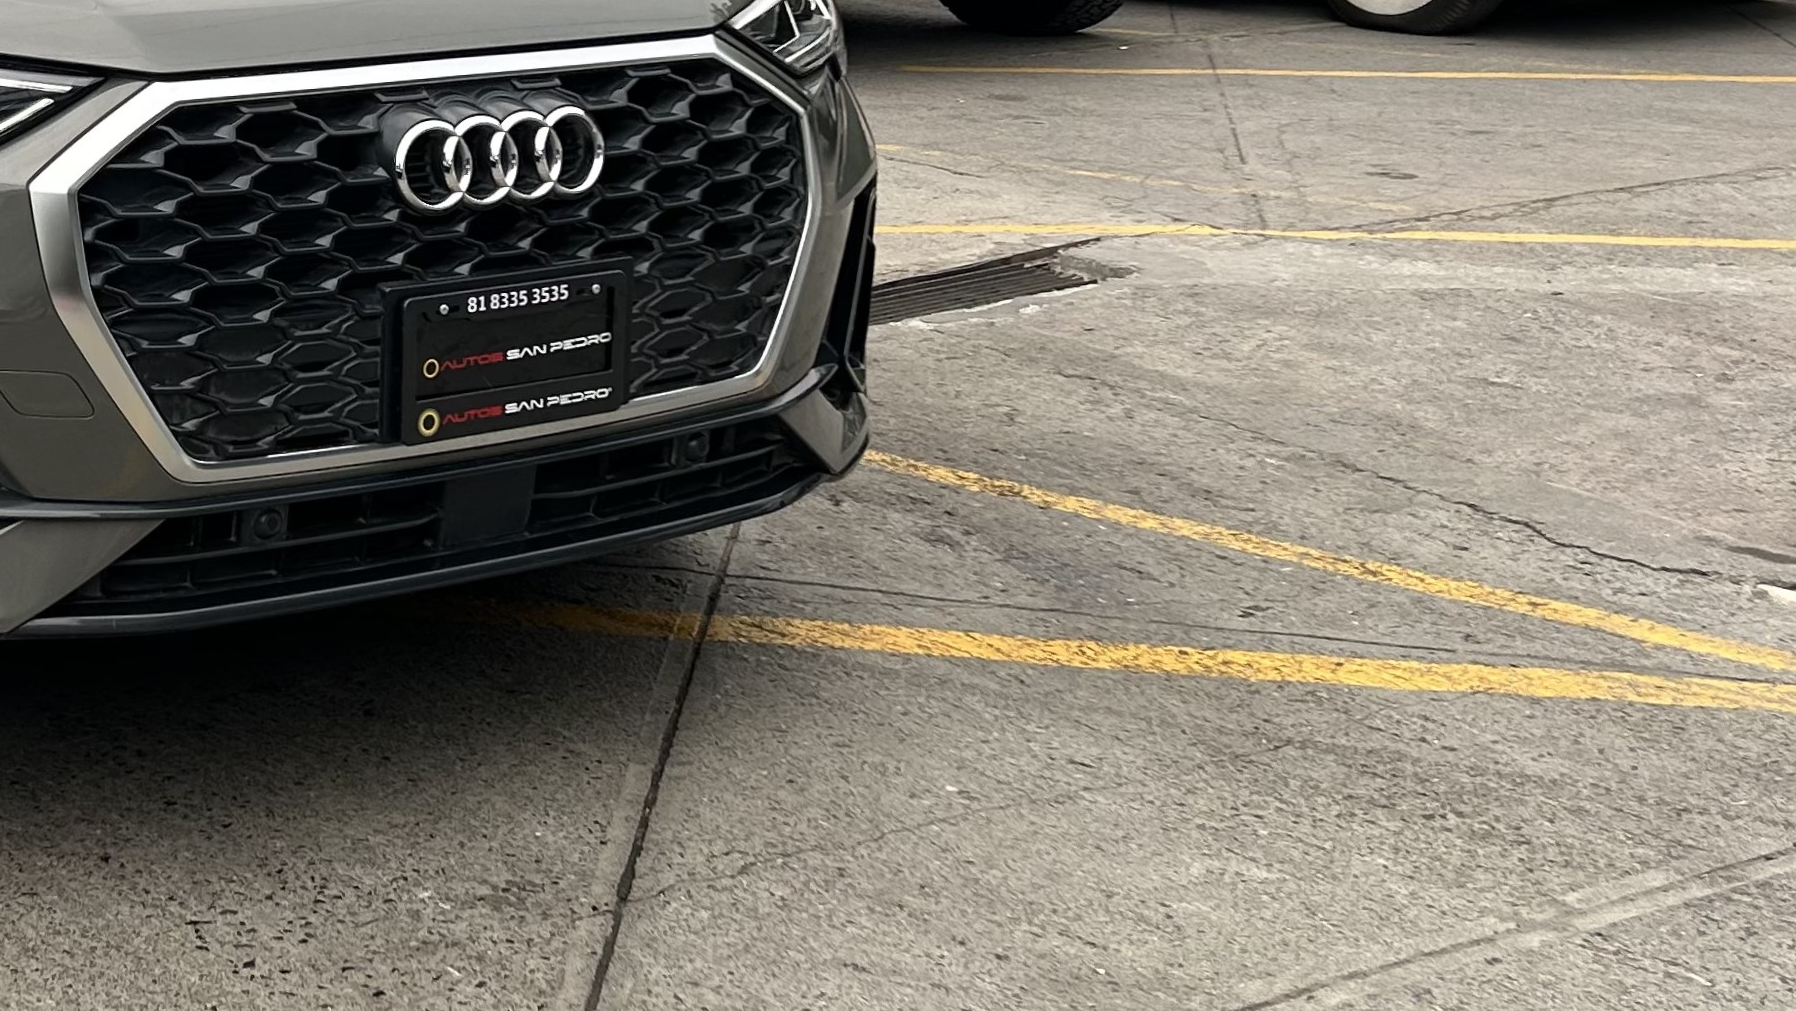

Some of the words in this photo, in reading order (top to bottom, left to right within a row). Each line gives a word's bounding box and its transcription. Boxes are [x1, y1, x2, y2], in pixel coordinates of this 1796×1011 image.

[467, 295, 487, 313] 81
[490, 290, 528, 310] 8335
[531, 284, 569, 304] 3535
[440, 351, 504, 372] AUTOS
[506, 344, 547, 361] SAN
[550, 331, 612, 353] PEDRO
[443, 405, 503, 425] AUTOS
[504, 397, 544, 414] SAN
